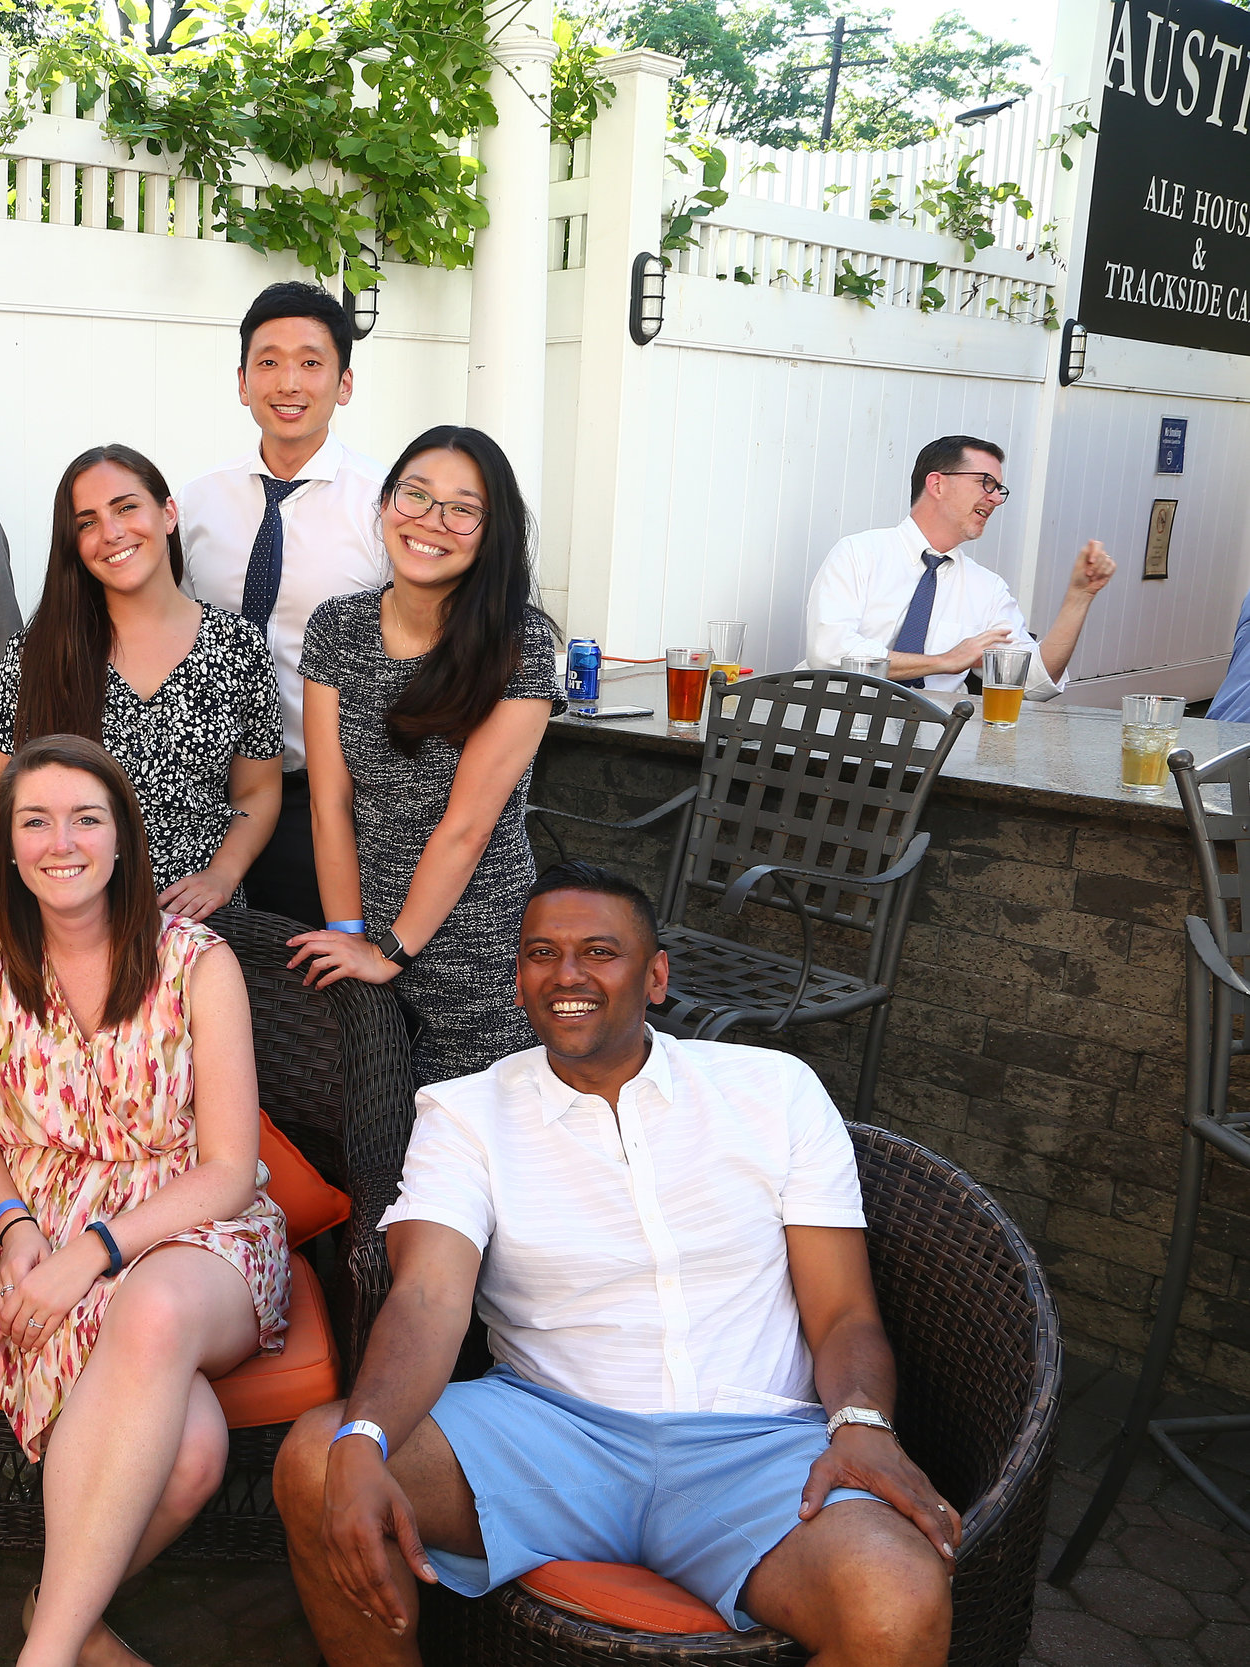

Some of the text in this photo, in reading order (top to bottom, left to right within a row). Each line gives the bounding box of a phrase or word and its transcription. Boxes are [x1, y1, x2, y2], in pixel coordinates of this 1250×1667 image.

[1143, 175, 1250, 238] ALE HOUS
[1192, 237, 1207, 271] &
[1104, 260, 1250, 323] TRACKSIDE CA
[569, 670, 578, 680] D
